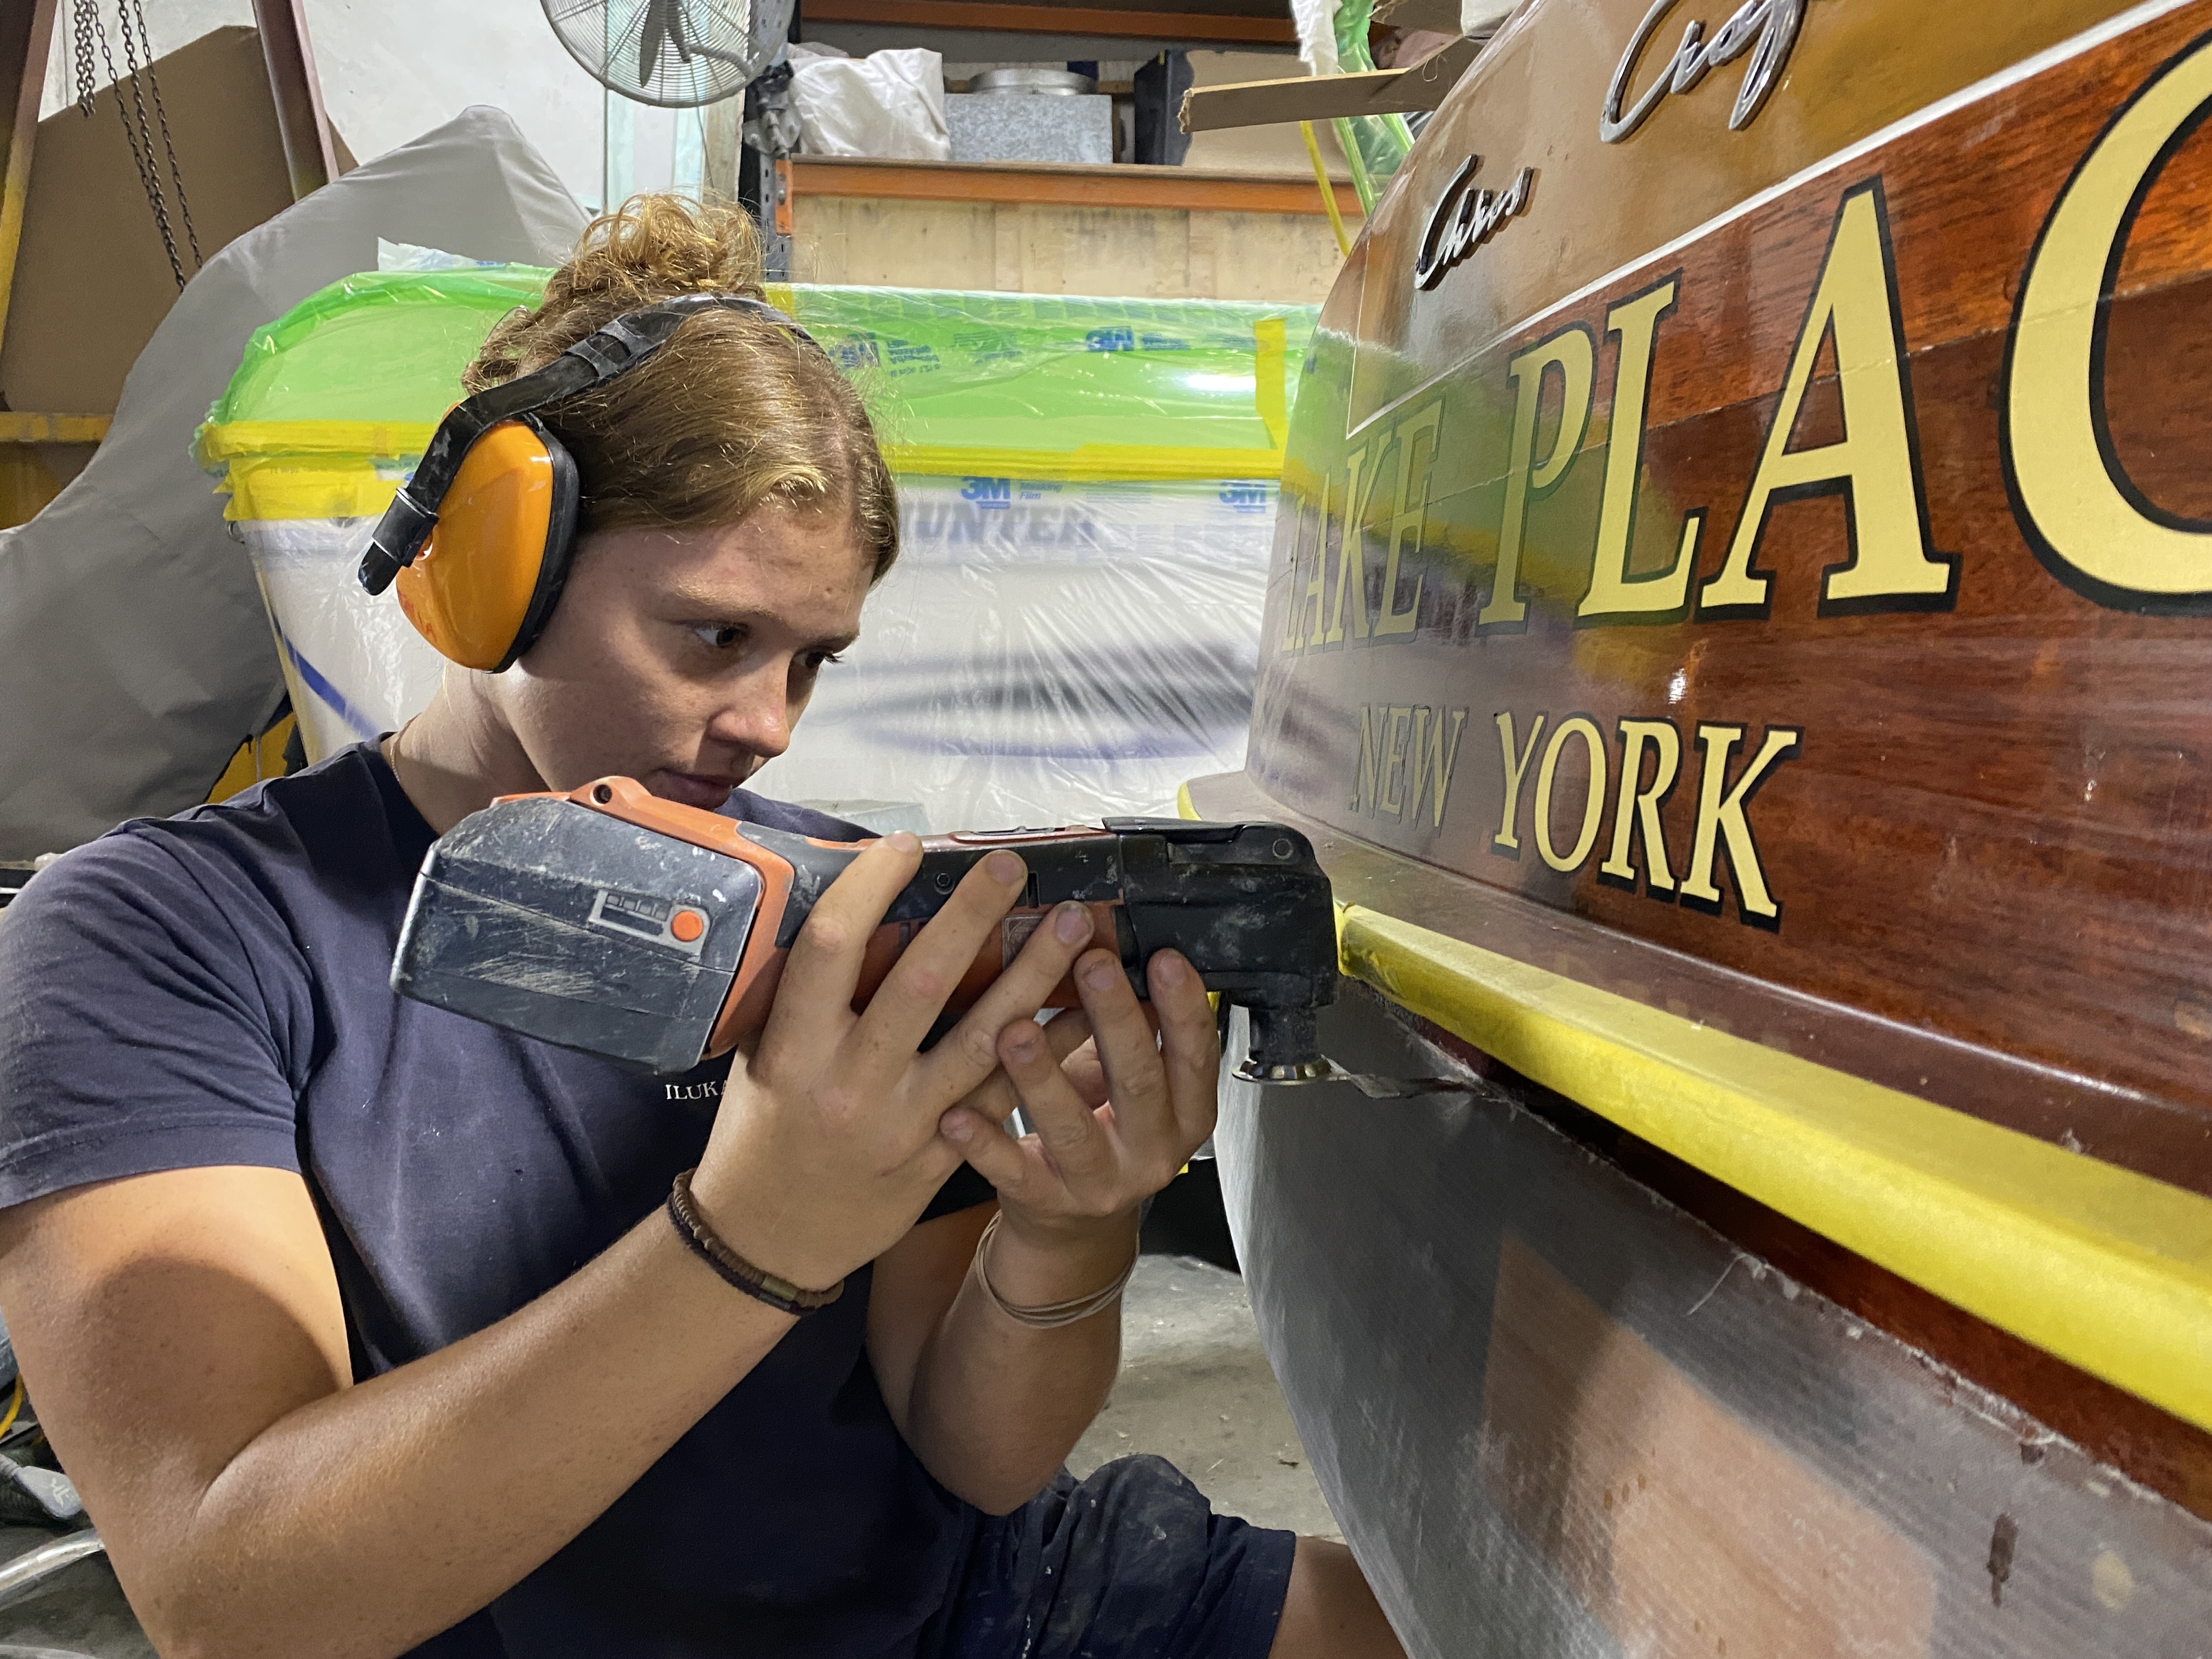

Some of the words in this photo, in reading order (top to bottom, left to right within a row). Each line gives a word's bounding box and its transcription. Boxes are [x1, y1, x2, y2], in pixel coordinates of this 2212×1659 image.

[961, 476, 1011, 501] 3M
[1218, 482, 1267, 504] 3M
[1280, 394, 1446, 657] LAKE
[1348, 702, 1469, 838] NEW
[1490, 708, 1805, 933] YORK
